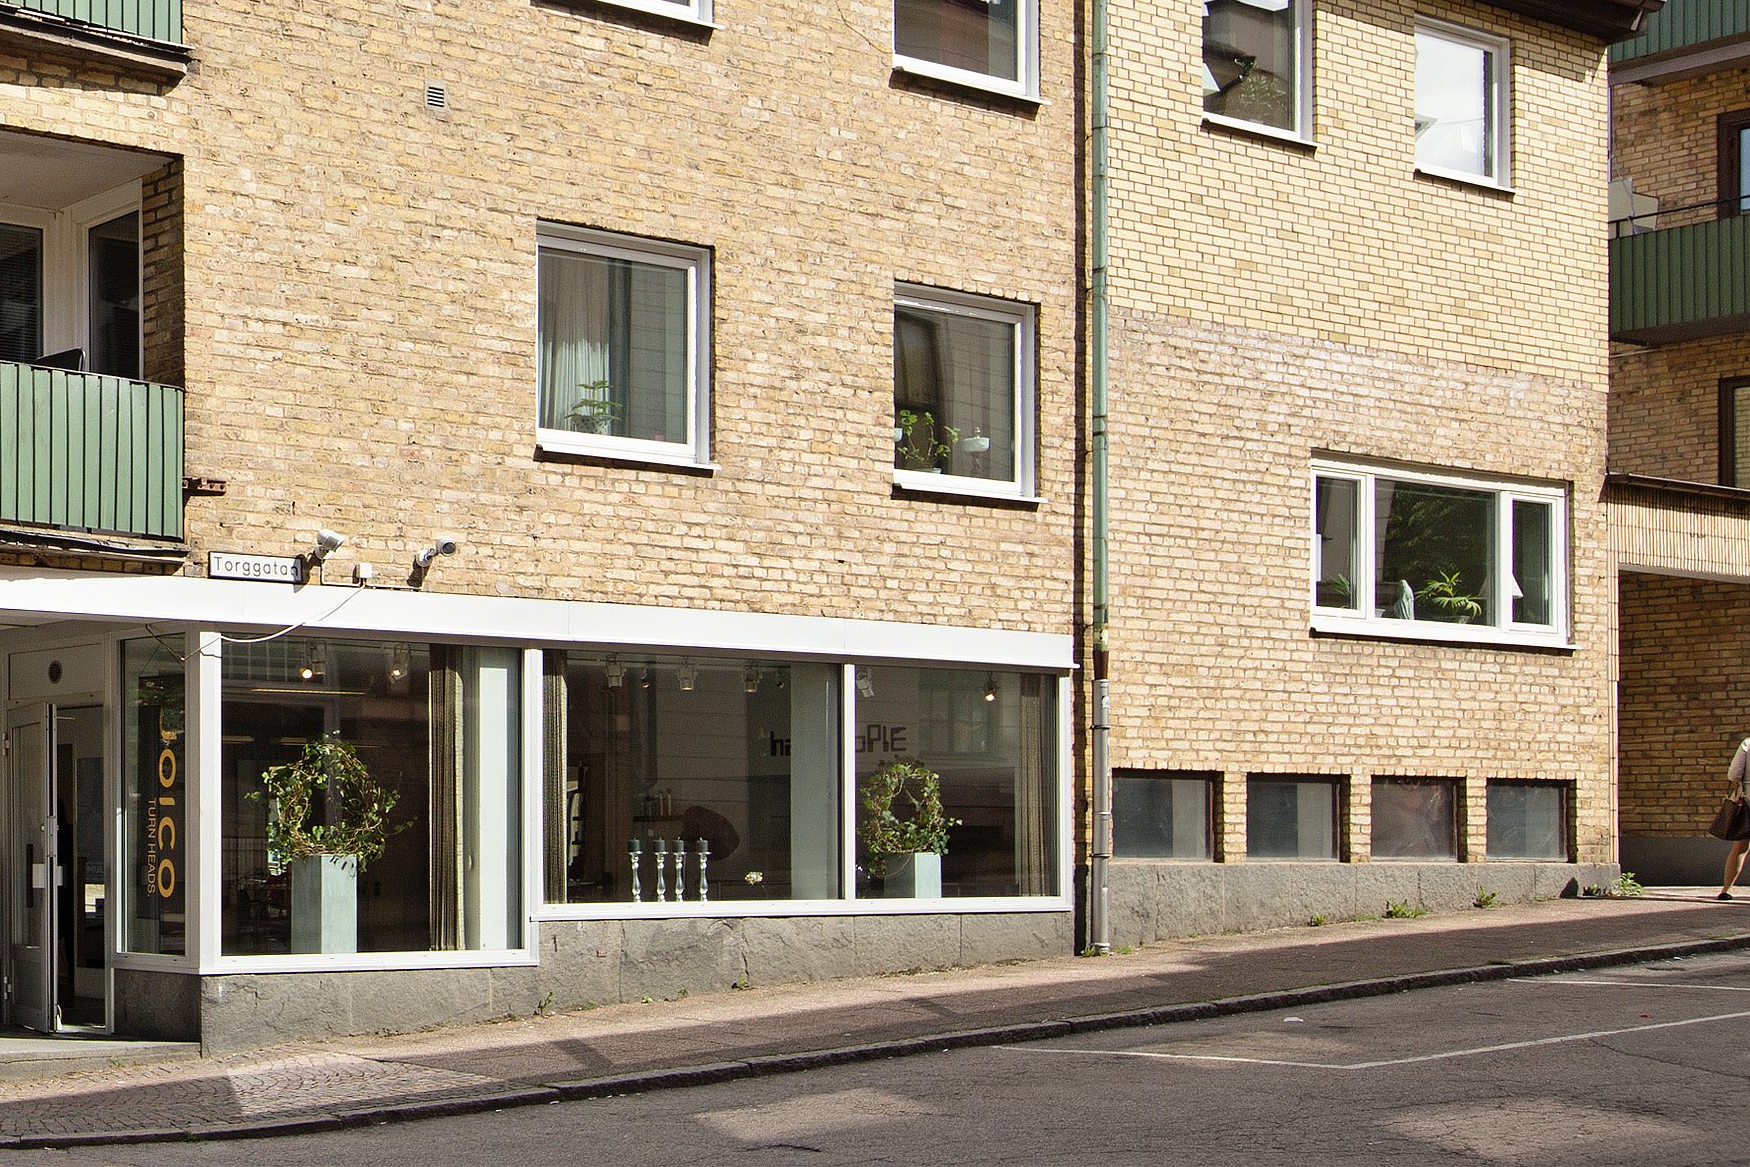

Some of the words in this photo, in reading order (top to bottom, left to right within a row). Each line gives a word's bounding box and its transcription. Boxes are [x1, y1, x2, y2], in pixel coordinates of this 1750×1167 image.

[213, 556, 299, 577] Torggatan
[147, 797, 157, 838] TURN
[147, 846, 157, 897] HEADS.
